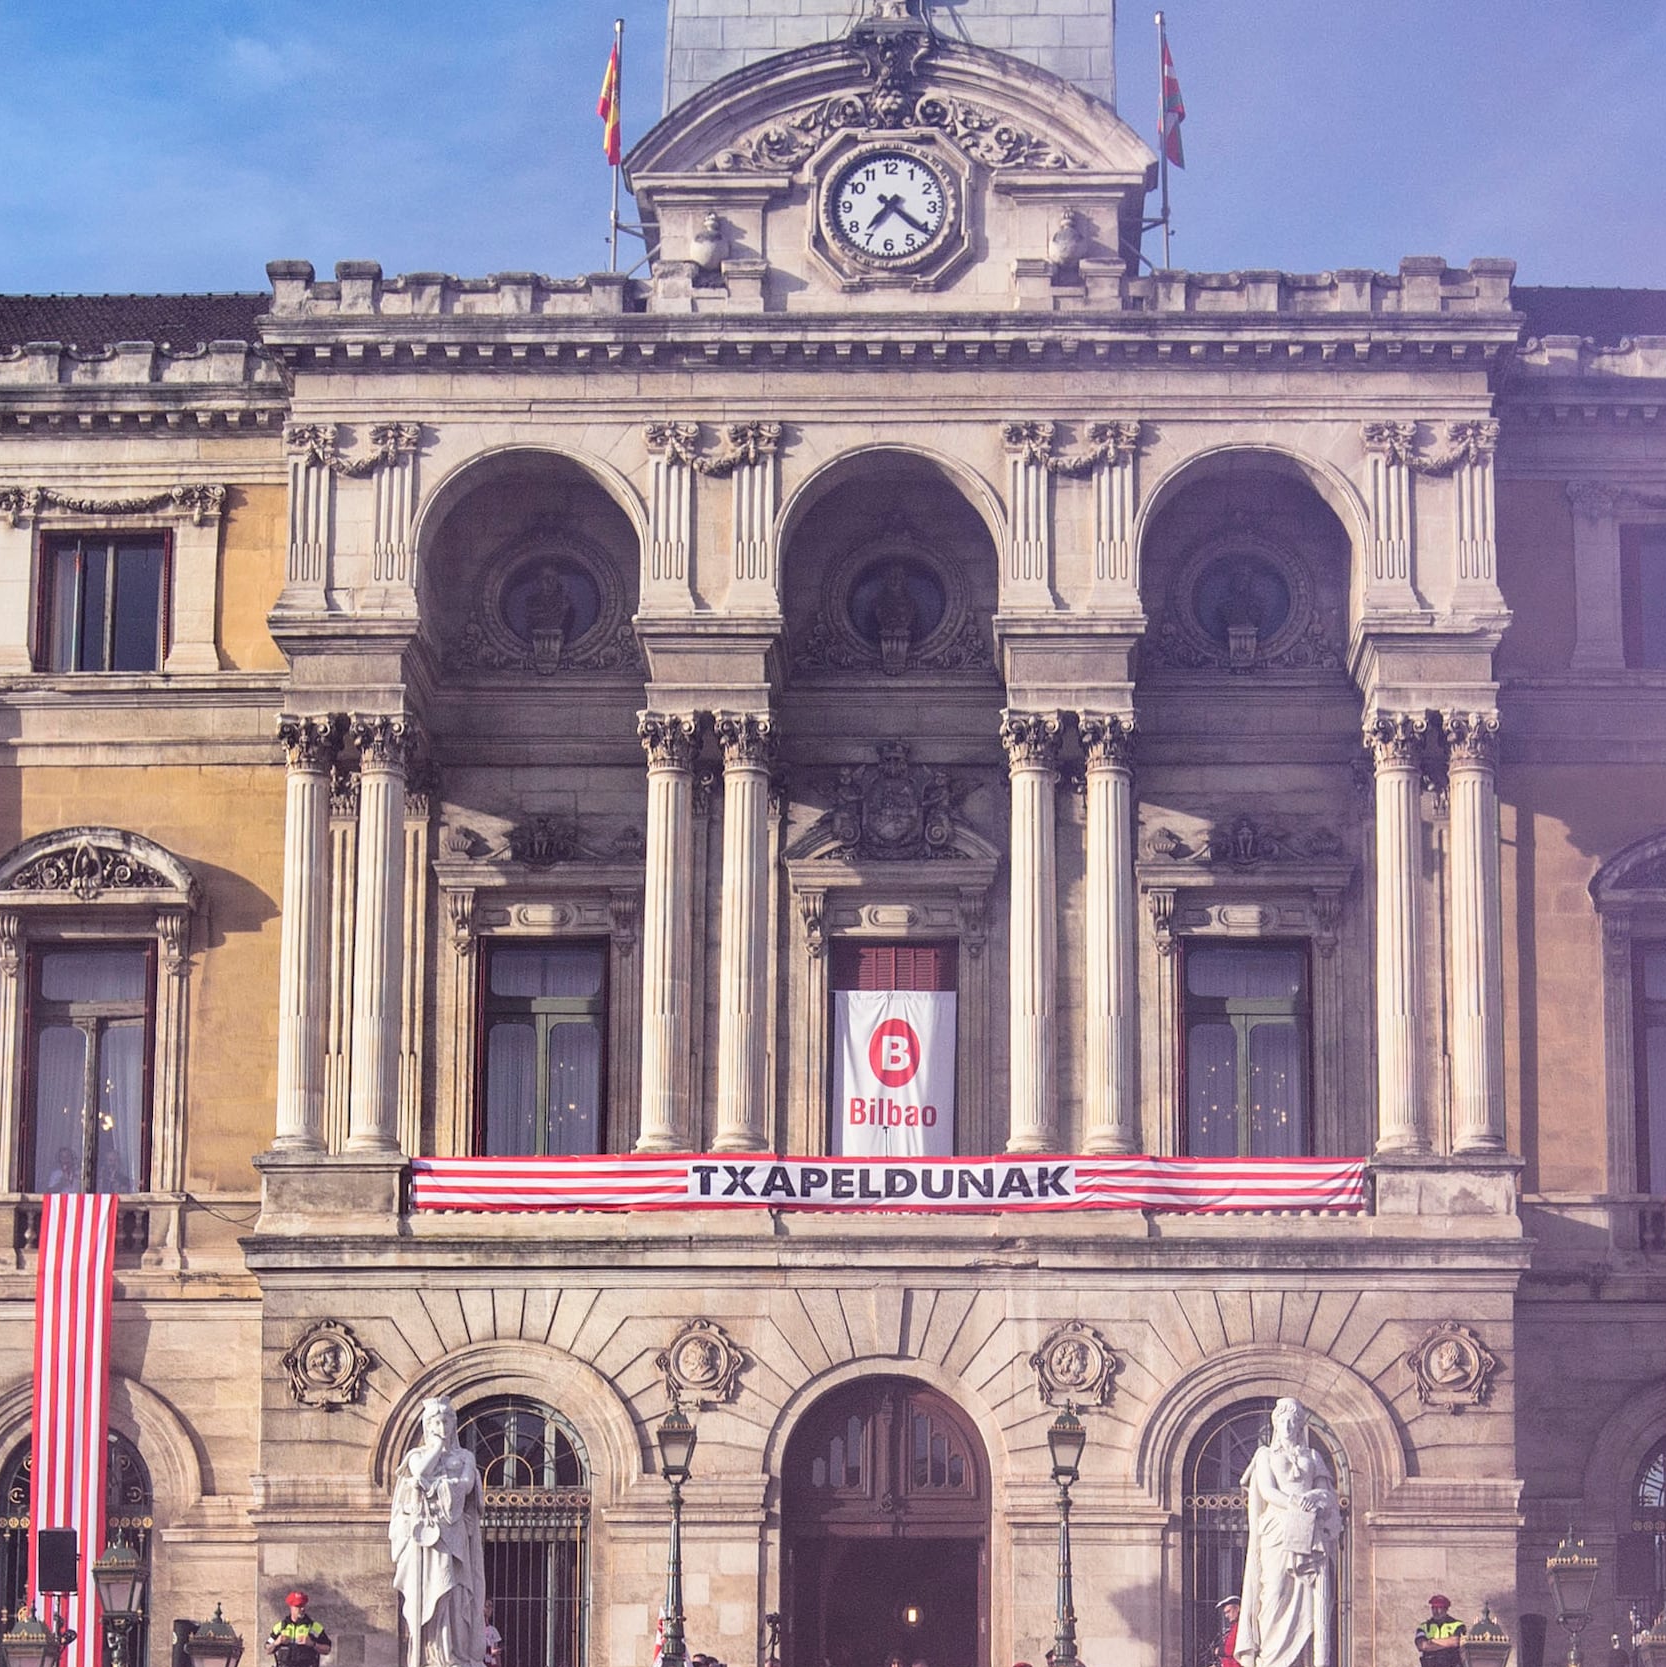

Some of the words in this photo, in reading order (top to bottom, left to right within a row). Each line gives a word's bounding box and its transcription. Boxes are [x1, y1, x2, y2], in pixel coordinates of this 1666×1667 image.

[863, 168, 876, 181] 11
[883, 162, 899, 175] 12
[908, 168, 914, 181] 1
[847, 182, 866, 195] 10
[922, 182, 932, 195] 2
[842, 201, 853, 213] 9
[926, 201, 937, 213] 3
[849, 220, 860, 233] 8
[864, 233, 874, 246] 7
[883, 239, 894, 251] 6
[905, 234, 915, 247] 5
[882, 1035, 911, 1072] B
[849, 1097, 937, 1127] Bilbao
[692, 1165, 1071, 1199] TXAPELDUNAK
